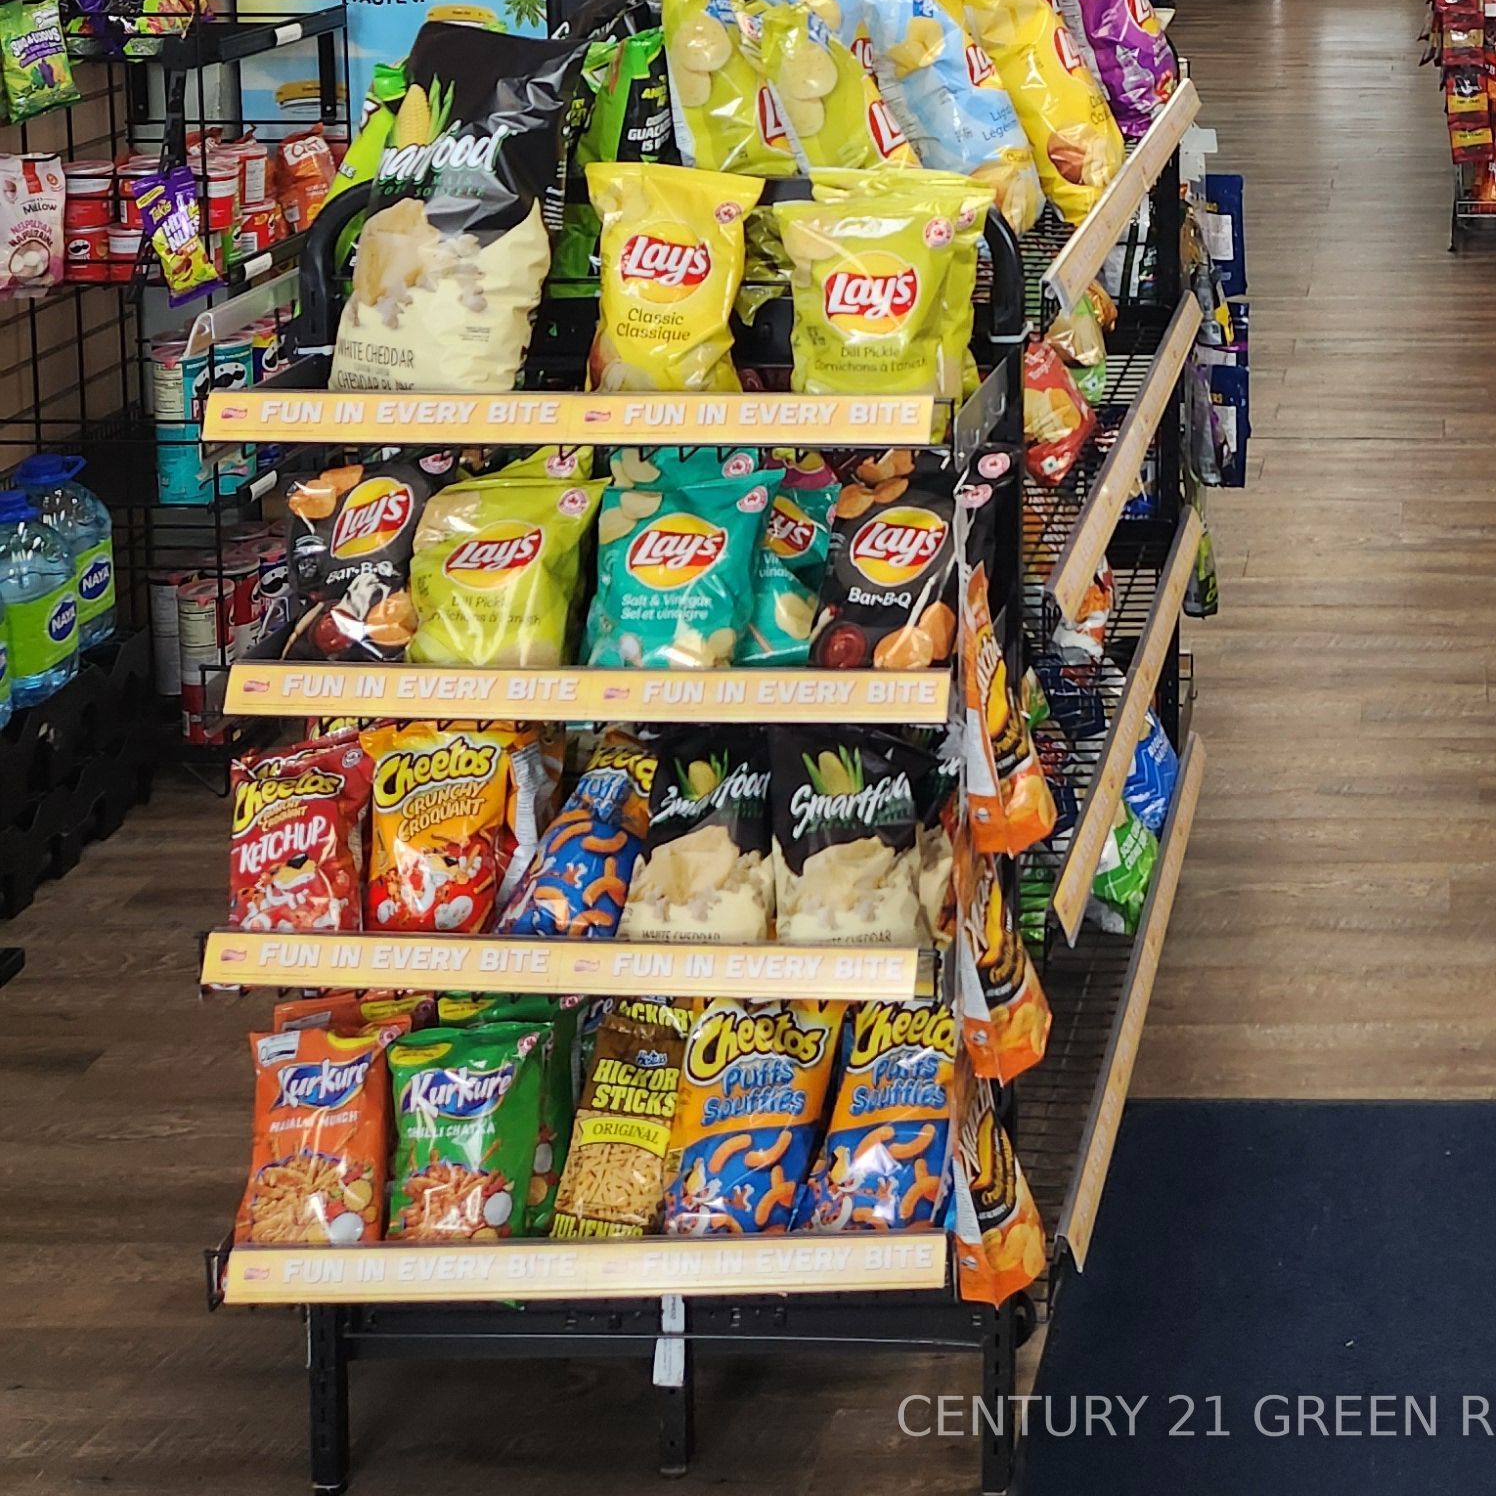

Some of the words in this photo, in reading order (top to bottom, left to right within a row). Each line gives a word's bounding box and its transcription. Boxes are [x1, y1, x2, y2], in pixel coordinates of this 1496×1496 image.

[624, 235, 710, 287] Lay's
[829, 272, 915, 319] Lay's
[616, 323, 691, 344] Classique
[628, 307, 684, 325] Classic
[338, 341, 363, 362] WHITE
[366, 343, 414, 369] CHEDDAR
[260, 400, 324, 424] FUN
[334, 401, 364, 424] IN
[377, 401, 477, 424] EVERY
[487, 401, 560, 425] BITE
[623, 402, 686, 425] FUN
[697, 403, 727, 425] IN
[739, 403, 837, 425] EVERY
[848, 402, 920, 425] BITE
[336, 492, 410, 545] Lay's
[453, 529, 544, 572] Lay's
[632, 525, 727, 570] Lay's
[855, 518, 946, 567] Lay's
[82, 567, 110, 592] NAYA
[51, 607, 77, 632] NAYA
[621, 607, 640, 621] Sel
[641, 608, 654, 620] et
[622, 594, 647, 608] Salt
[282, 673, 345, 697] FUN
[355, 675, 386, 698] IN
[397, 676, 497, 699] EVERY
[506, 677, 579, 701] BITE
[643, 680, 705, 702] FUN
[716, 680, 746, 702] IN
[757, 680, 857, 702] EVERY
[867, 680, 938, 703] BITE
[373, 737, 497, 812] Cheetos
[232, 770, 344, 837] Cheetos
[403, 780, 487, 820] CRUNCHY
[397, 798, 486, 842] CROQUANT
[239, 816, 328, 874] KETCHUP
[259, 943, 322, 968] FUN
[331, 945, 361, 969] IN
[372, 945, 473, 971] EVERY
[481, 947, 551, 973] BITE
[613, 953, 673, 977] FUN
[685, 954, 714, 978] IN
[725, 954, 824, 979] EVERY
[834, 955, 907, 979] BITE
[689, 1010, 824, 1083] Cheetos
[277, 1058, 372, 1109] Kurkure
[593, 1058, 680, 1092] HICKOR
[723, 1064, 795, 1096] Puffs
[874, 1053, 940, 1086] Puffs
[408, 1066, 514, 1119] Kurkure
[592, 1083, 679, 1118] STICKS
[593, 1123, 661, 1144] ORIGINAL
[283, 1256, 344, 1283] FUN
[355, 1256, 385, 1282] IN
[397, 1255, 496, 1281] EVERY
[506, 1253, 578, 1279] BITE
[641, 1252, 703, 1278] FUN
[715, 1250, 743, 1275] IN
[756, 1247, 855, 1273] EVERY
[865, 1244, 935, 1270] BITE
